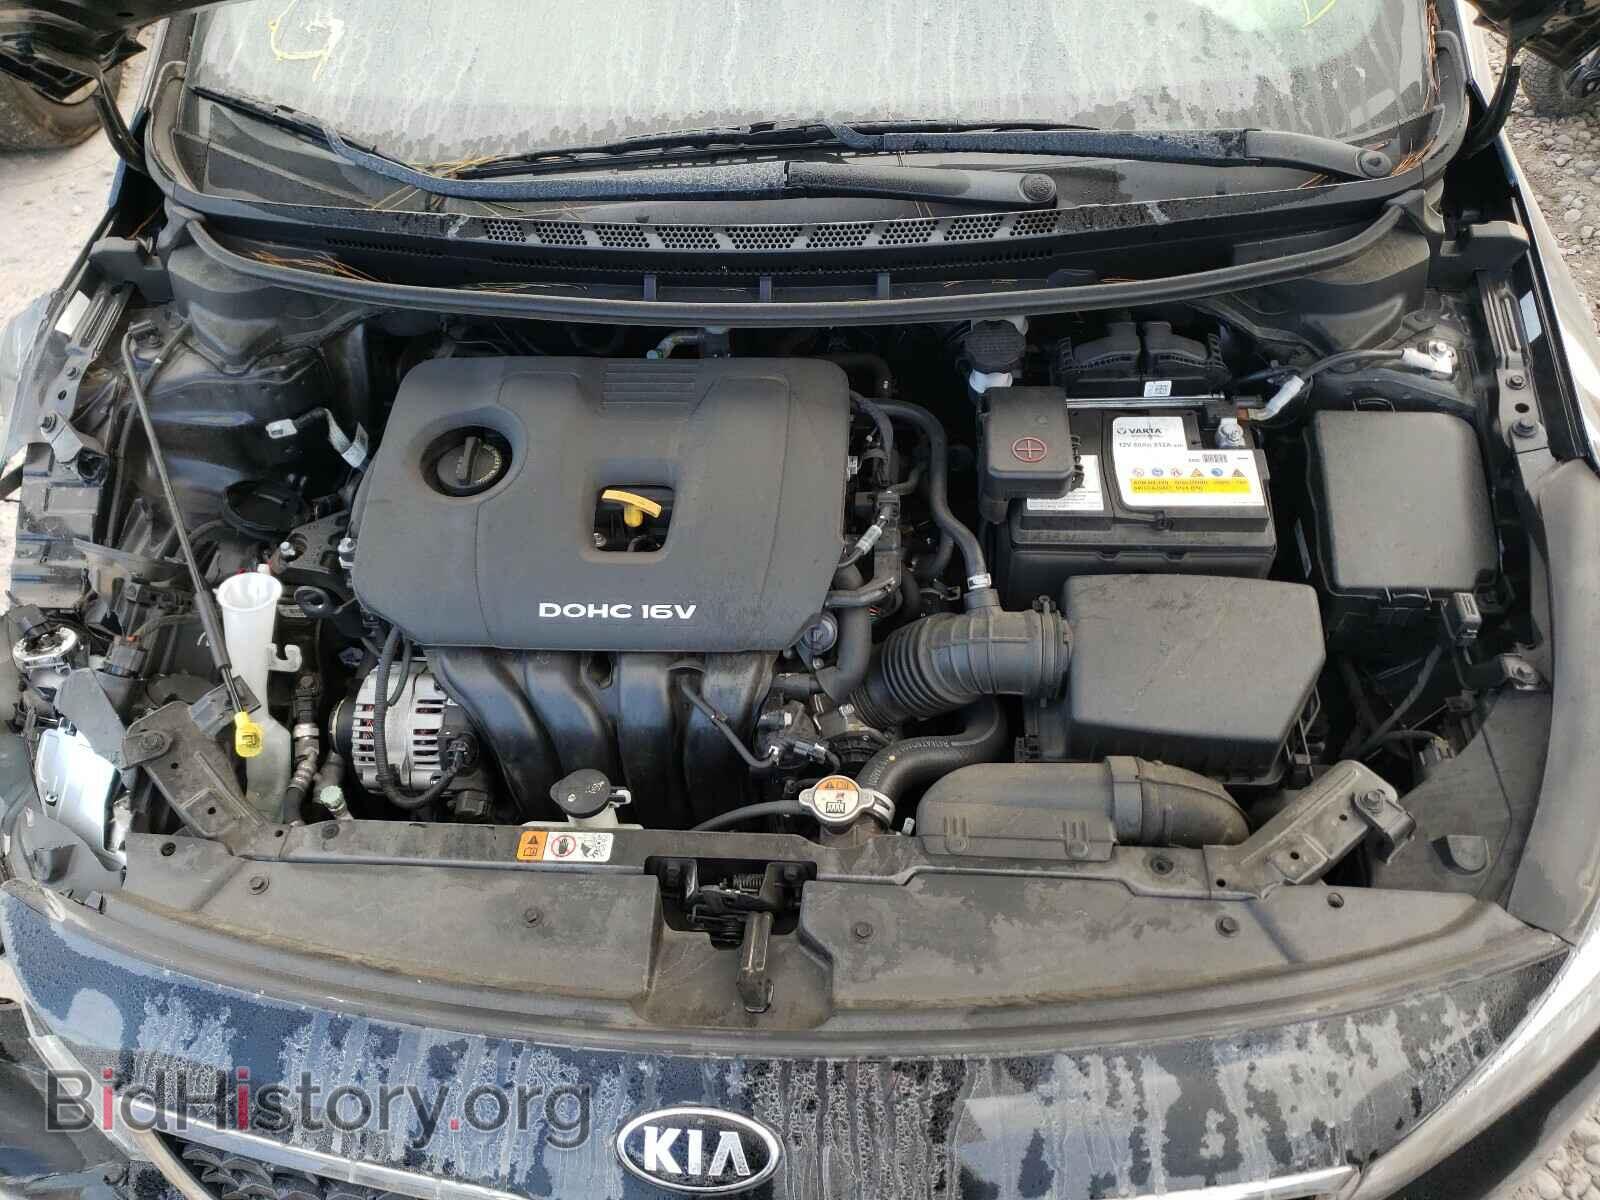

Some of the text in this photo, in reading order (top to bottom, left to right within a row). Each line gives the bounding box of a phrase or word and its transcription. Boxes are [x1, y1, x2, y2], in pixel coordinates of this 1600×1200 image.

[539, 602, 697, 620] DOHC 16V
[644, 1125, 751, 1176] KIA
